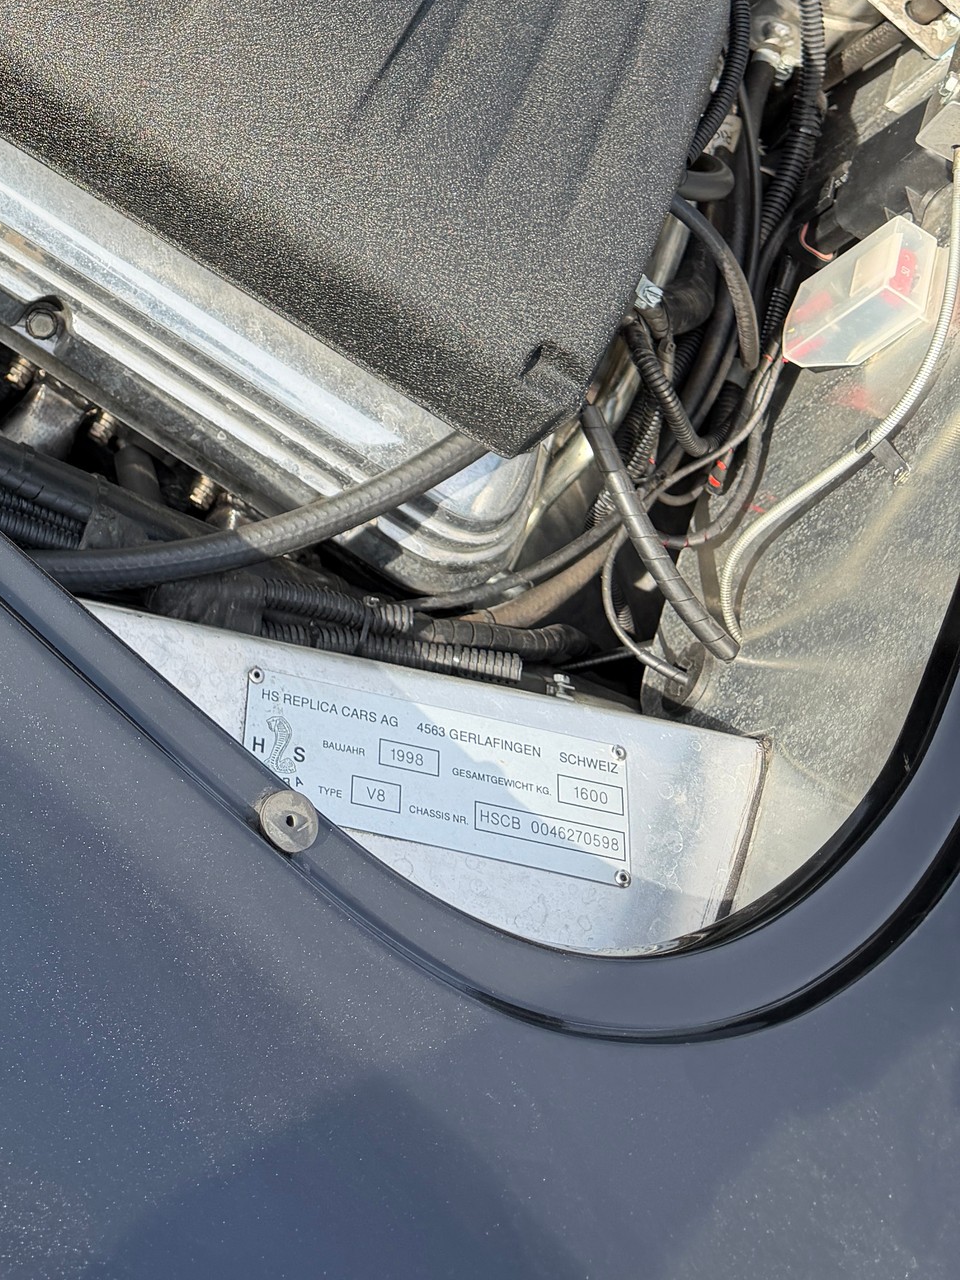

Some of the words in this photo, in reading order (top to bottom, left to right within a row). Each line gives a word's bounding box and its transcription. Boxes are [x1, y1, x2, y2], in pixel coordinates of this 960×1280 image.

[261, 688, 280, 702] HS
[283, 693, 338, 715] REPLICA
[341, 705, 378, 723] CARS
[380, 714, 399, 728] AG
[416, 722, 446, 738] 4563
[449, 728, 542, 758] GERLAFINGEN
[559, 752, 620, 775] SCHWEIZ
[252, 736, 265, 753] H
[293, 746, 306, 762] S
[322, 740, 366, 757] BAUJAHR
[390, 748, 424, 767] 1998
[318, 785, 343, 799] TYPE
[366, 786, 386, 803] V8
[452, 767, 534, 792] GESAMTGEWICHT
[574, 786, 609, 805] 1600
[409, 804, 451, 821] CHASSIS
[480, 809, 522, 830] HSCB
[530, 820, 620, 852] 0046270598
